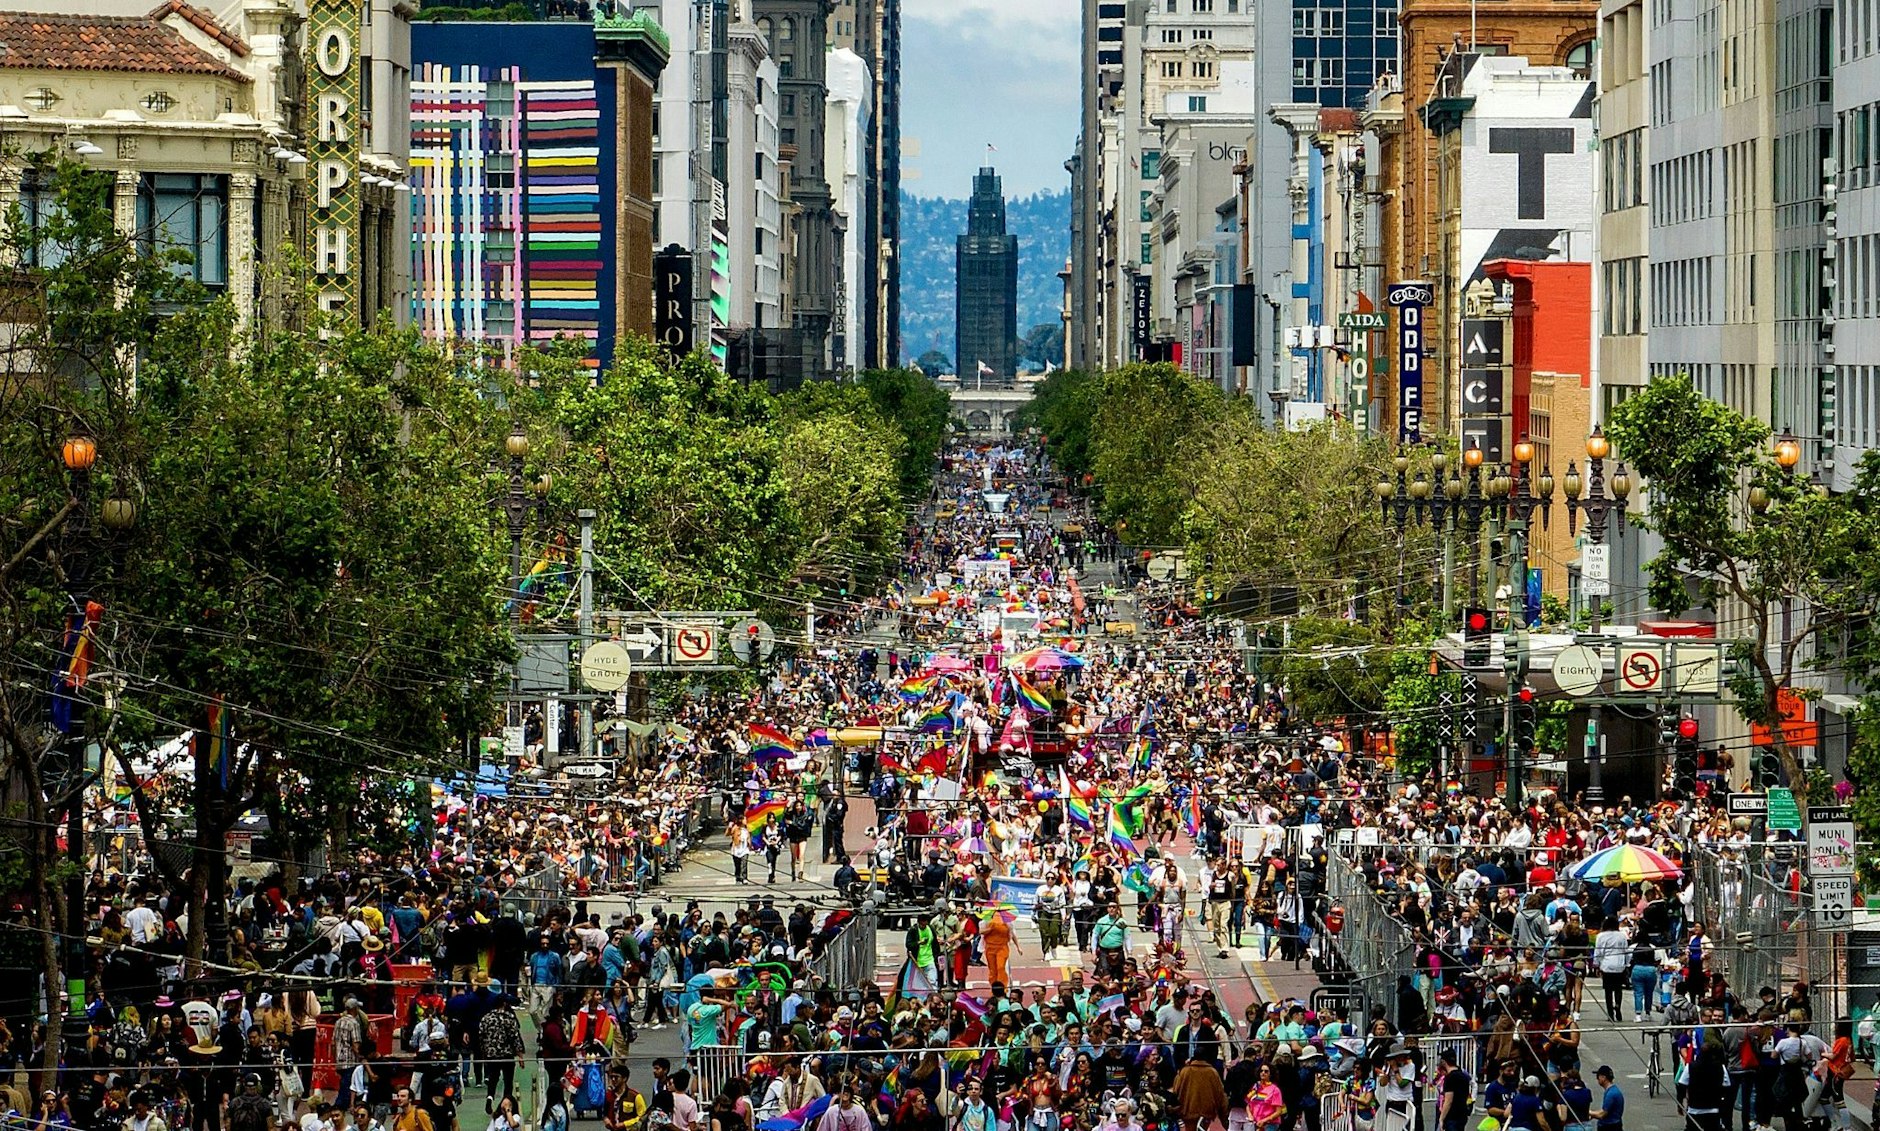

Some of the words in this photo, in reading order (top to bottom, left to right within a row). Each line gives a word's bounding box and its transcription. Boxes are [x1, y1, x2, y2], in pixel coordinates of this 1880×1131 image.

[315, 25, 351, 380] ORPHE
[1138, 289, 1146, 339] ZELOS
[1343, 314, 1385, 327] AIDA
[1404, 307, 1418, 372] ODD
[590, 670, 622, 678] GROVE
[1560, 666, 1597, 675] EIGHTH
[1685, 667, 1709, 676] MUST
[1763, 728, 1805, 738] MKET
[1735, 800, 1753, 808] ONE
[1813, 812, 1829, 820] LEFT
[1831, 811, 1849, 819] LANE
[1818, 829, 1845, 839] MUNI
[1816, 881, 1849, 889] SPEED
[1821, 903, 1845, 921] 10
[1319, 998, 1337, 1009] LEFT
